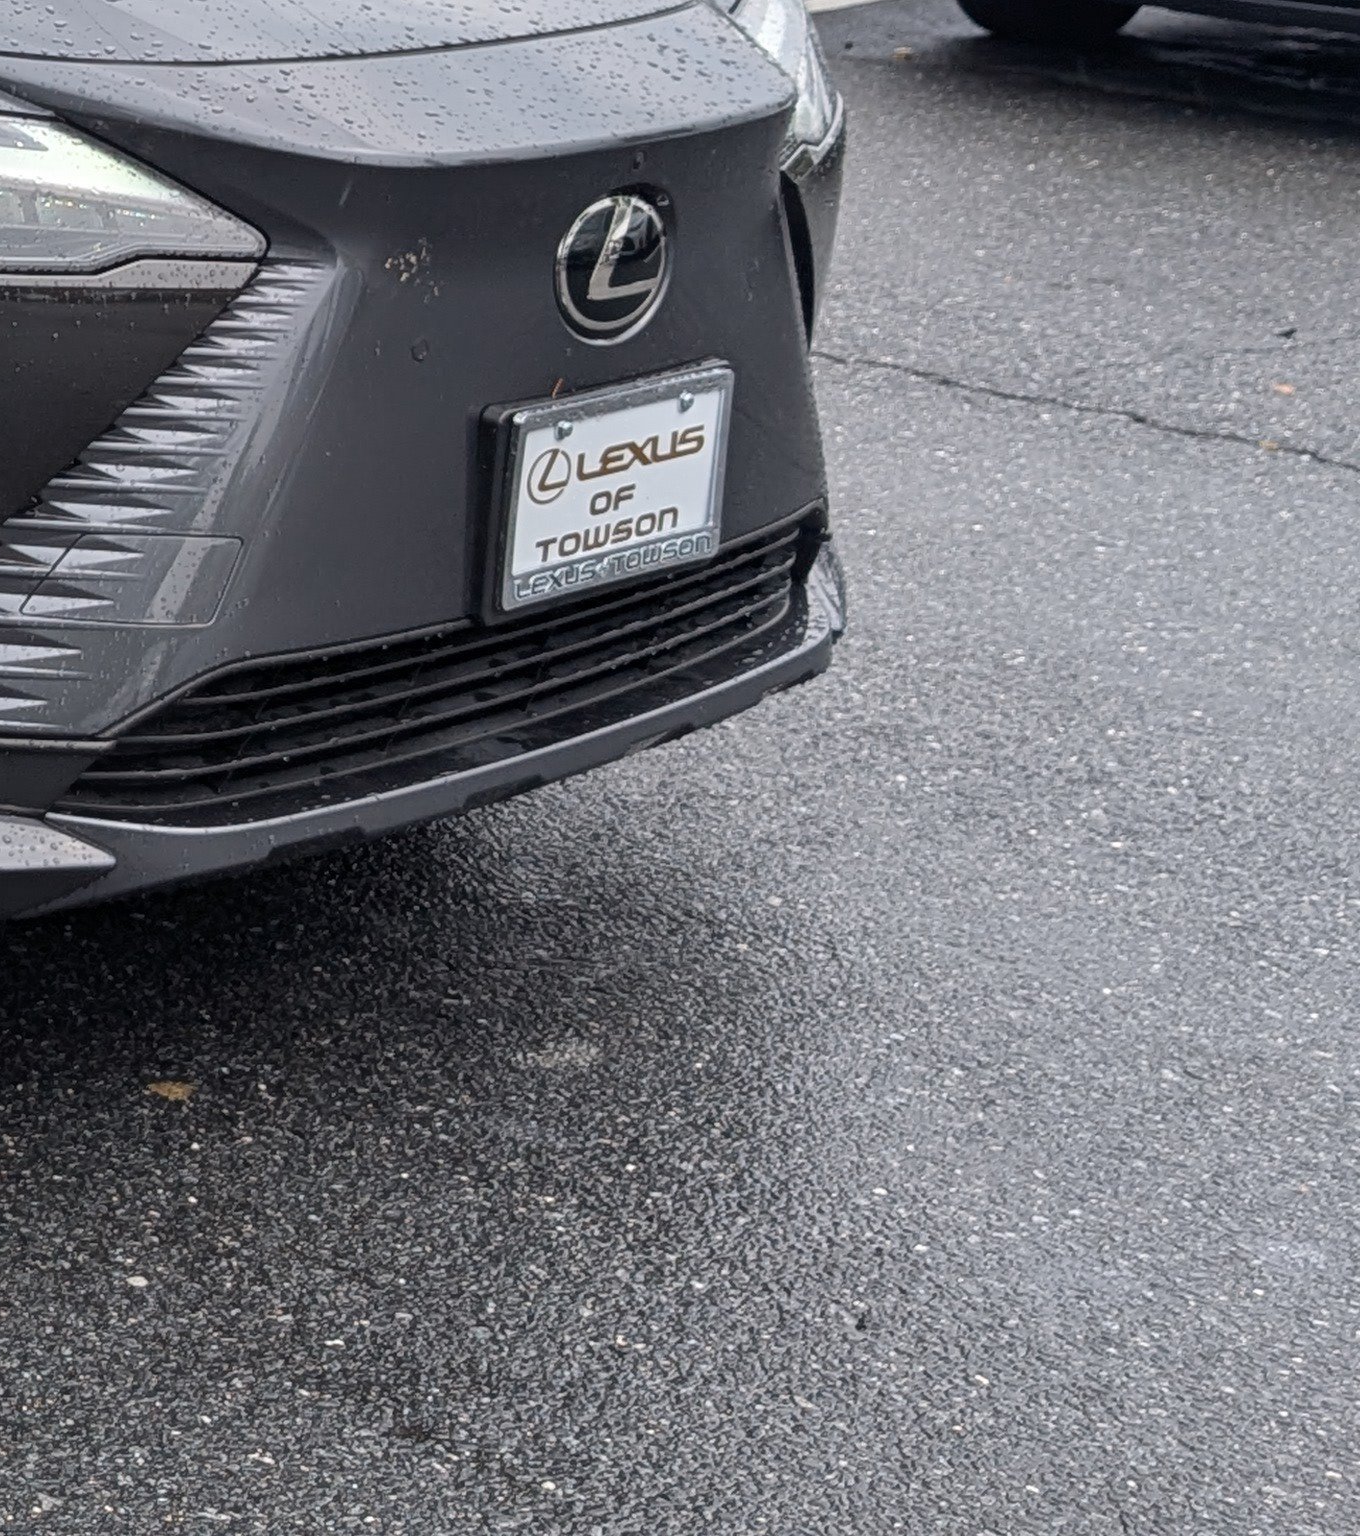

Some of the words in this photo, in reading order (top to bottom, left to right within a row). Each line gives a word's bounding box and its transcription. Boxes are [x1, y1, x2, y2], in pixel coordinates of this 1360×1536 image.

[576, 424, 705, 482] LEXUS
[589, 483, 636, 516] OF
[535, 506, 679, 563] TOWSON
[514, 559, 598, 599] LEXUS
